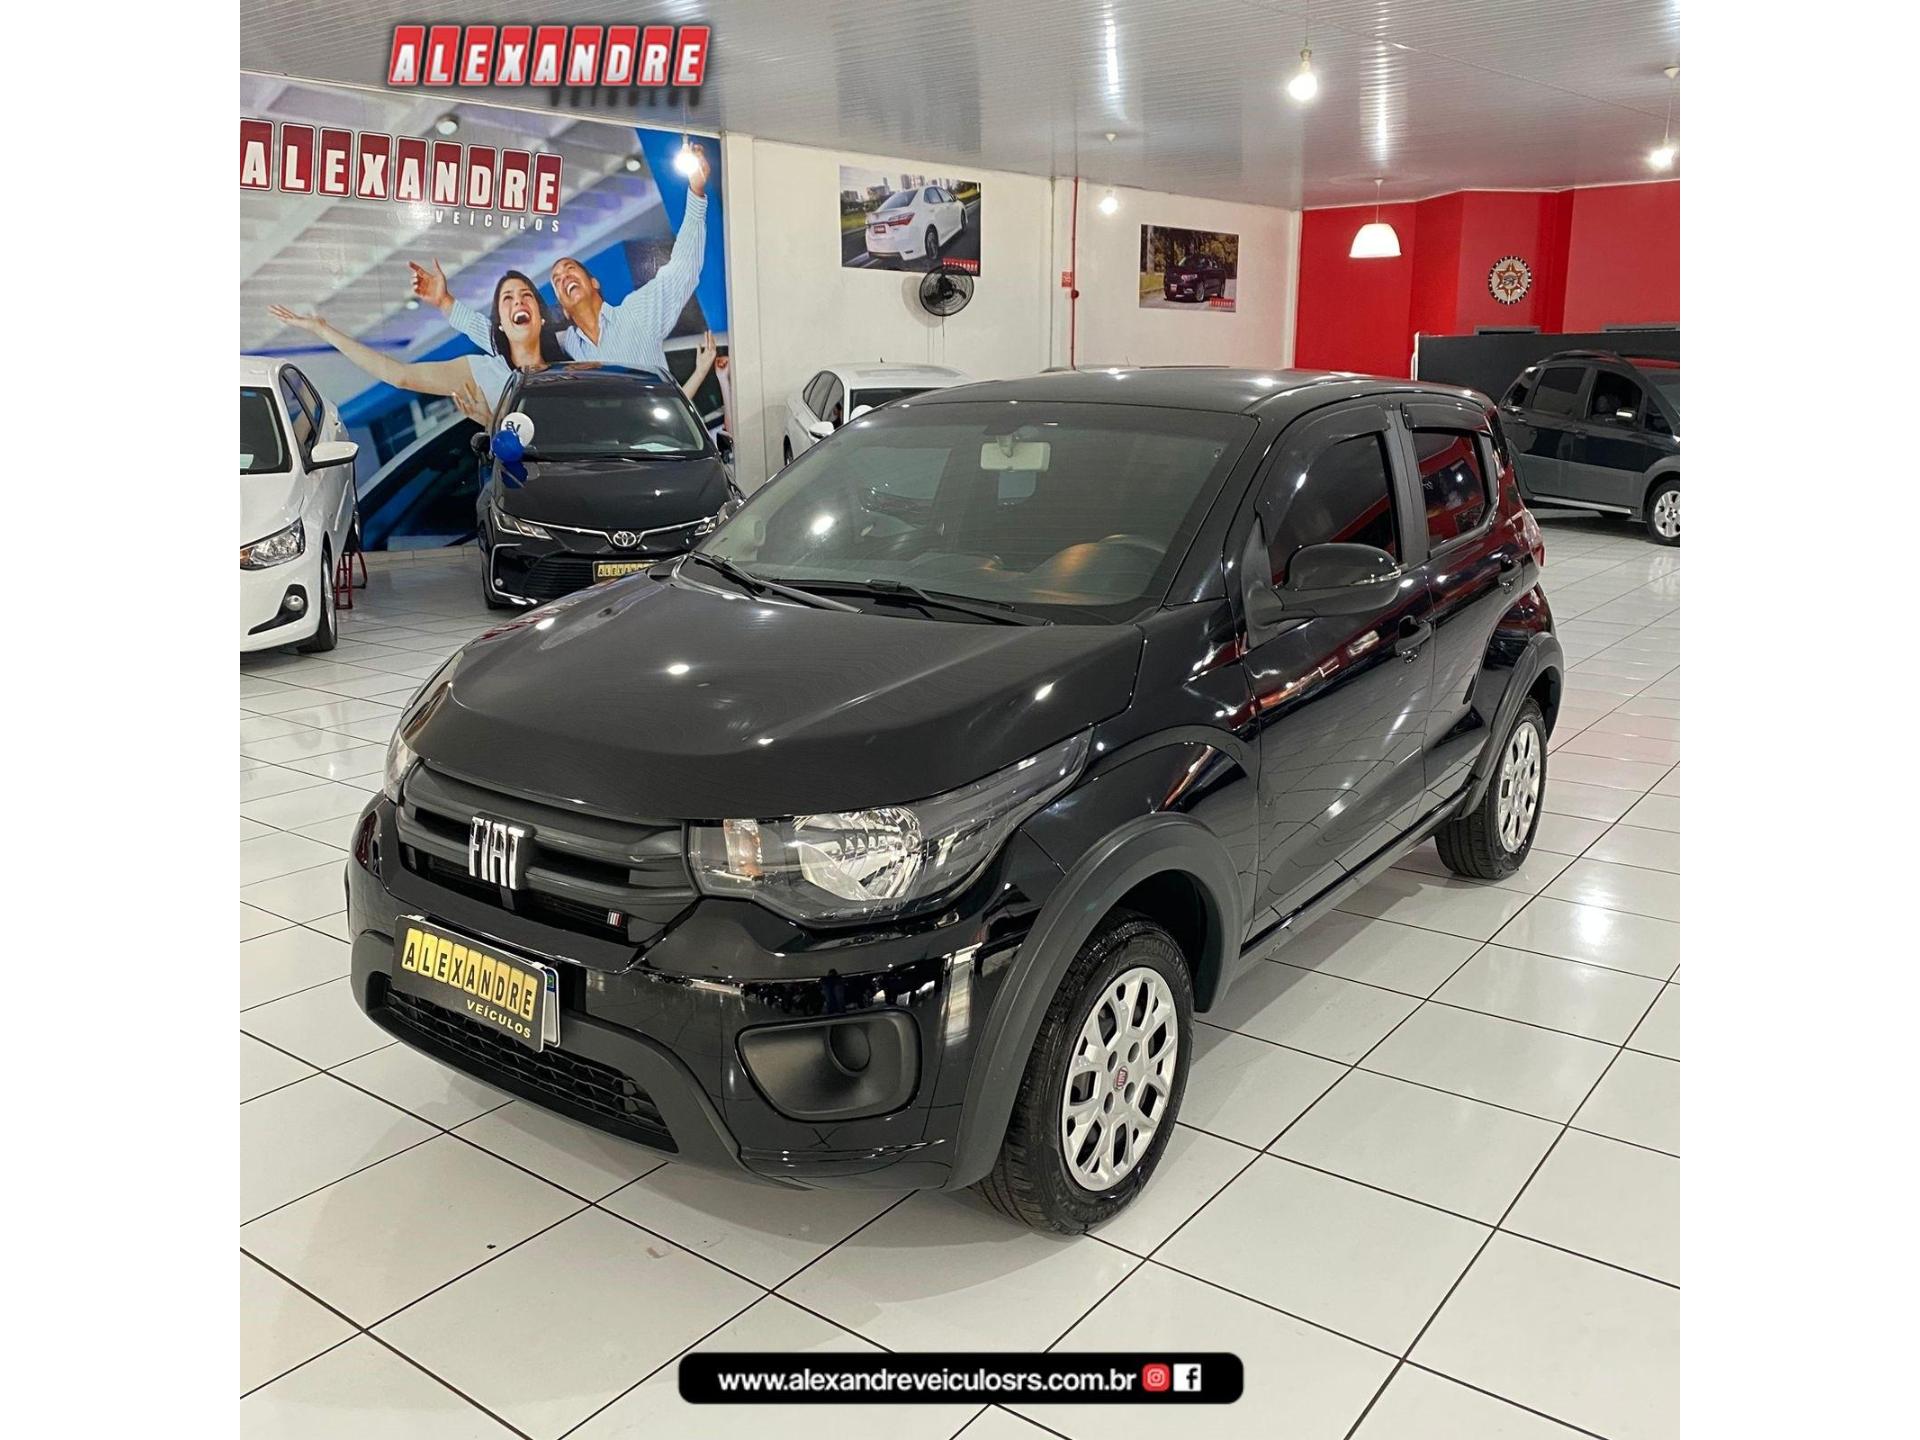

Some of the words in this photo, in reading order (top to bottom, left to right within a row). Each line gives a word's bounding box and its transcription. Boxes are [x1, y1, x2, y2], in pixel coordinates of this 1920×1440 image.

[241, 141, 556, 212] ALEXANDRE
[435, 210, 560, 233] VEÍCULOS
[468, 816, 526, 890] FIAT
[404, 942, 533, 1016] ALEXANDRE
[466, 999, 532, 1039] VEÍCULOS
